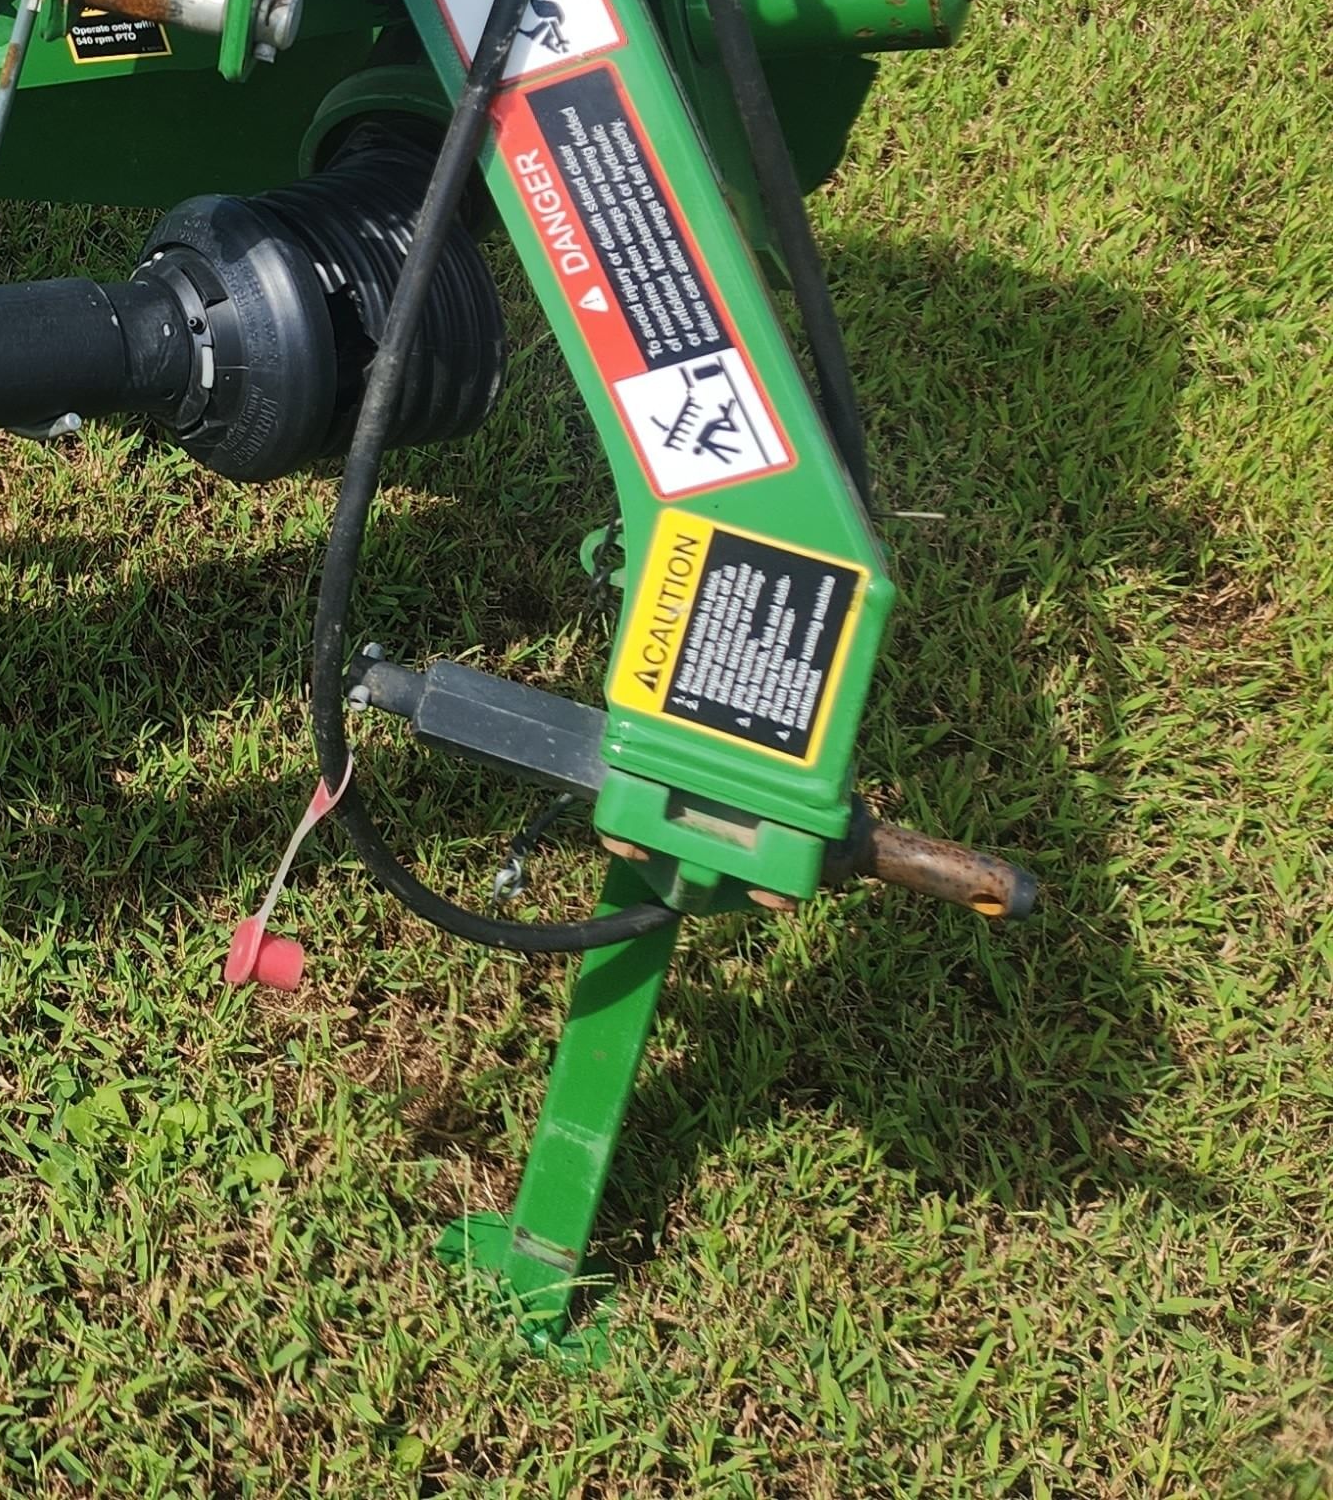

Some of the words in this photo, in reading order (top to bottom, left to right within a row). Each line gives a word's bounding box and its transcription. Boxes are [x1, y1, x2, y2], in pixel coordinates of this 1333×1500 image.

[72, 25, 110, 36] Operate
[111, 22, 132, 34] only
[76, 36, 93, 46] 540
[95, 35, 114, 46] rpm
[115, 32, 137, 42] PTO
[559, 104, 590, 147] folded
[607, 115, 643, 164] rapidly.
[554, 141, 583, 177] clear
[577, 143, 610, 184] being
[588, 121, 630, 182] hydraulic
[617, 179, 634, 198] or
[627, 162, 649, 186] fall
[570, 175, 600, 214] stand
[597, 181, 617, 206] are
[637, 183, 656, 201] to
[515, 149, 591, 275] DANGER
[605, 203, 638, 245] wings
[644, 197, 677, 240] wings
[586, 211, 617, 252] death
[621, 196, 667, 271] Mechanical
[606, 249, 624, 267] or
[622, 243, 651, 281] when
[661, 237, 690, 275] allow
[611, 263, 644, 304] injury
[680, 272, 702, 300] can
[638, 279, 677, 338] machine
[655, 270, 695, 332] unfolded.
[627, 302, 657, 340] avoid
[689, 298, 721, 343] failure
[643, 337, 665, 358] To
[664, 335, 684, 354] of
[685, 329, 703, 348] or
[717, 578, 734, 596] off
[721, 563, 738, 580] all
[733, 562, 755, 598] power
[642, 533, 702, 665] CAUTION
[698, 599, 713, 612] in
[710, 594, 729, 620] shut
[724, 596, 743, 630] motor
[809, 573, 836, 621] machine
[686, 610, 710, 649] shields
[704, 618, 722, 641] and
[741, 609, 753, 622] or
[764, 604, 783, 629] and
[712, 628, 734, 664] and/or
[725, 621, 752, 671] servicing
[758, 627, 776, 649] feet
[799, 619, 825, 662] running
[683, 648, 698, 663] all
[688, 639, 718, 697] Disengage
[767, 644, 786, 671] from
[674, 662, 696, 692] Keep
[703, 663, 726, 701] engine
[714, 668, 737, 705] before
[761, 669, 781, 700] away
[791, 660, 811, 690] leave
[728, 683, 748, 710] ging
[740, 682, 763, 714] Keep
[754, 698, 772, 718] ing
[766, 686, 788, 722] driven
[785, 688, 802, 709] not
[780, 708, 796, 726] Do
